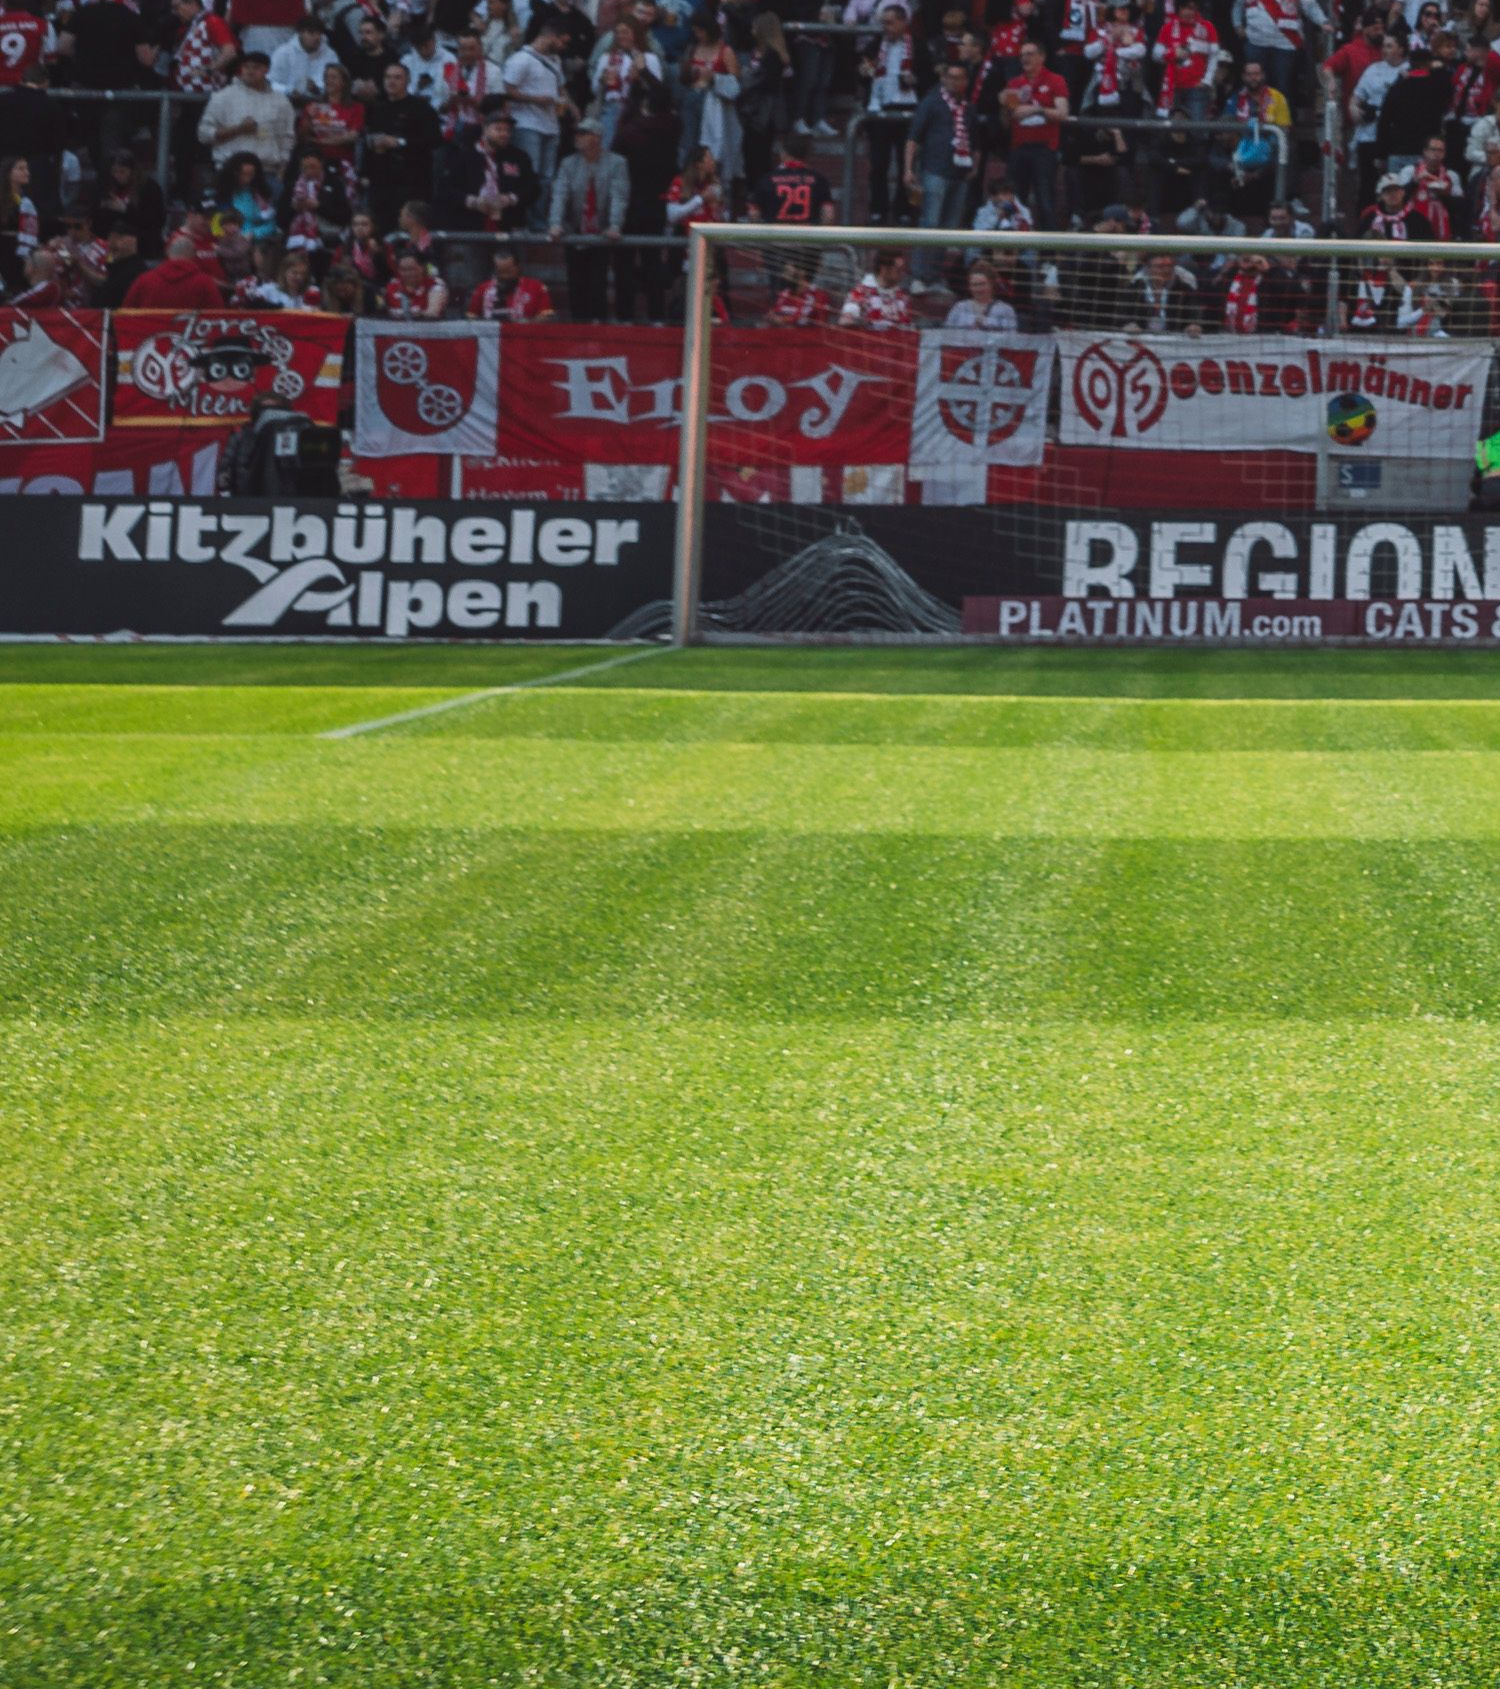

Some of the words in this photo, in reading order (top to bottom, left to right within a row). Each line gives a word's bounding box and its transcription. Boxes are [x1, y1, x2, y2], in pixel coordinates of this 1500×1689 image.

[78, 502, 639, 568] Kitzbüheler
[221, 558, 562, 637] Alpen
[1001, 601, 1322, 638] PLATINUM.com
[1365, 603, 1479, 639] CATS
